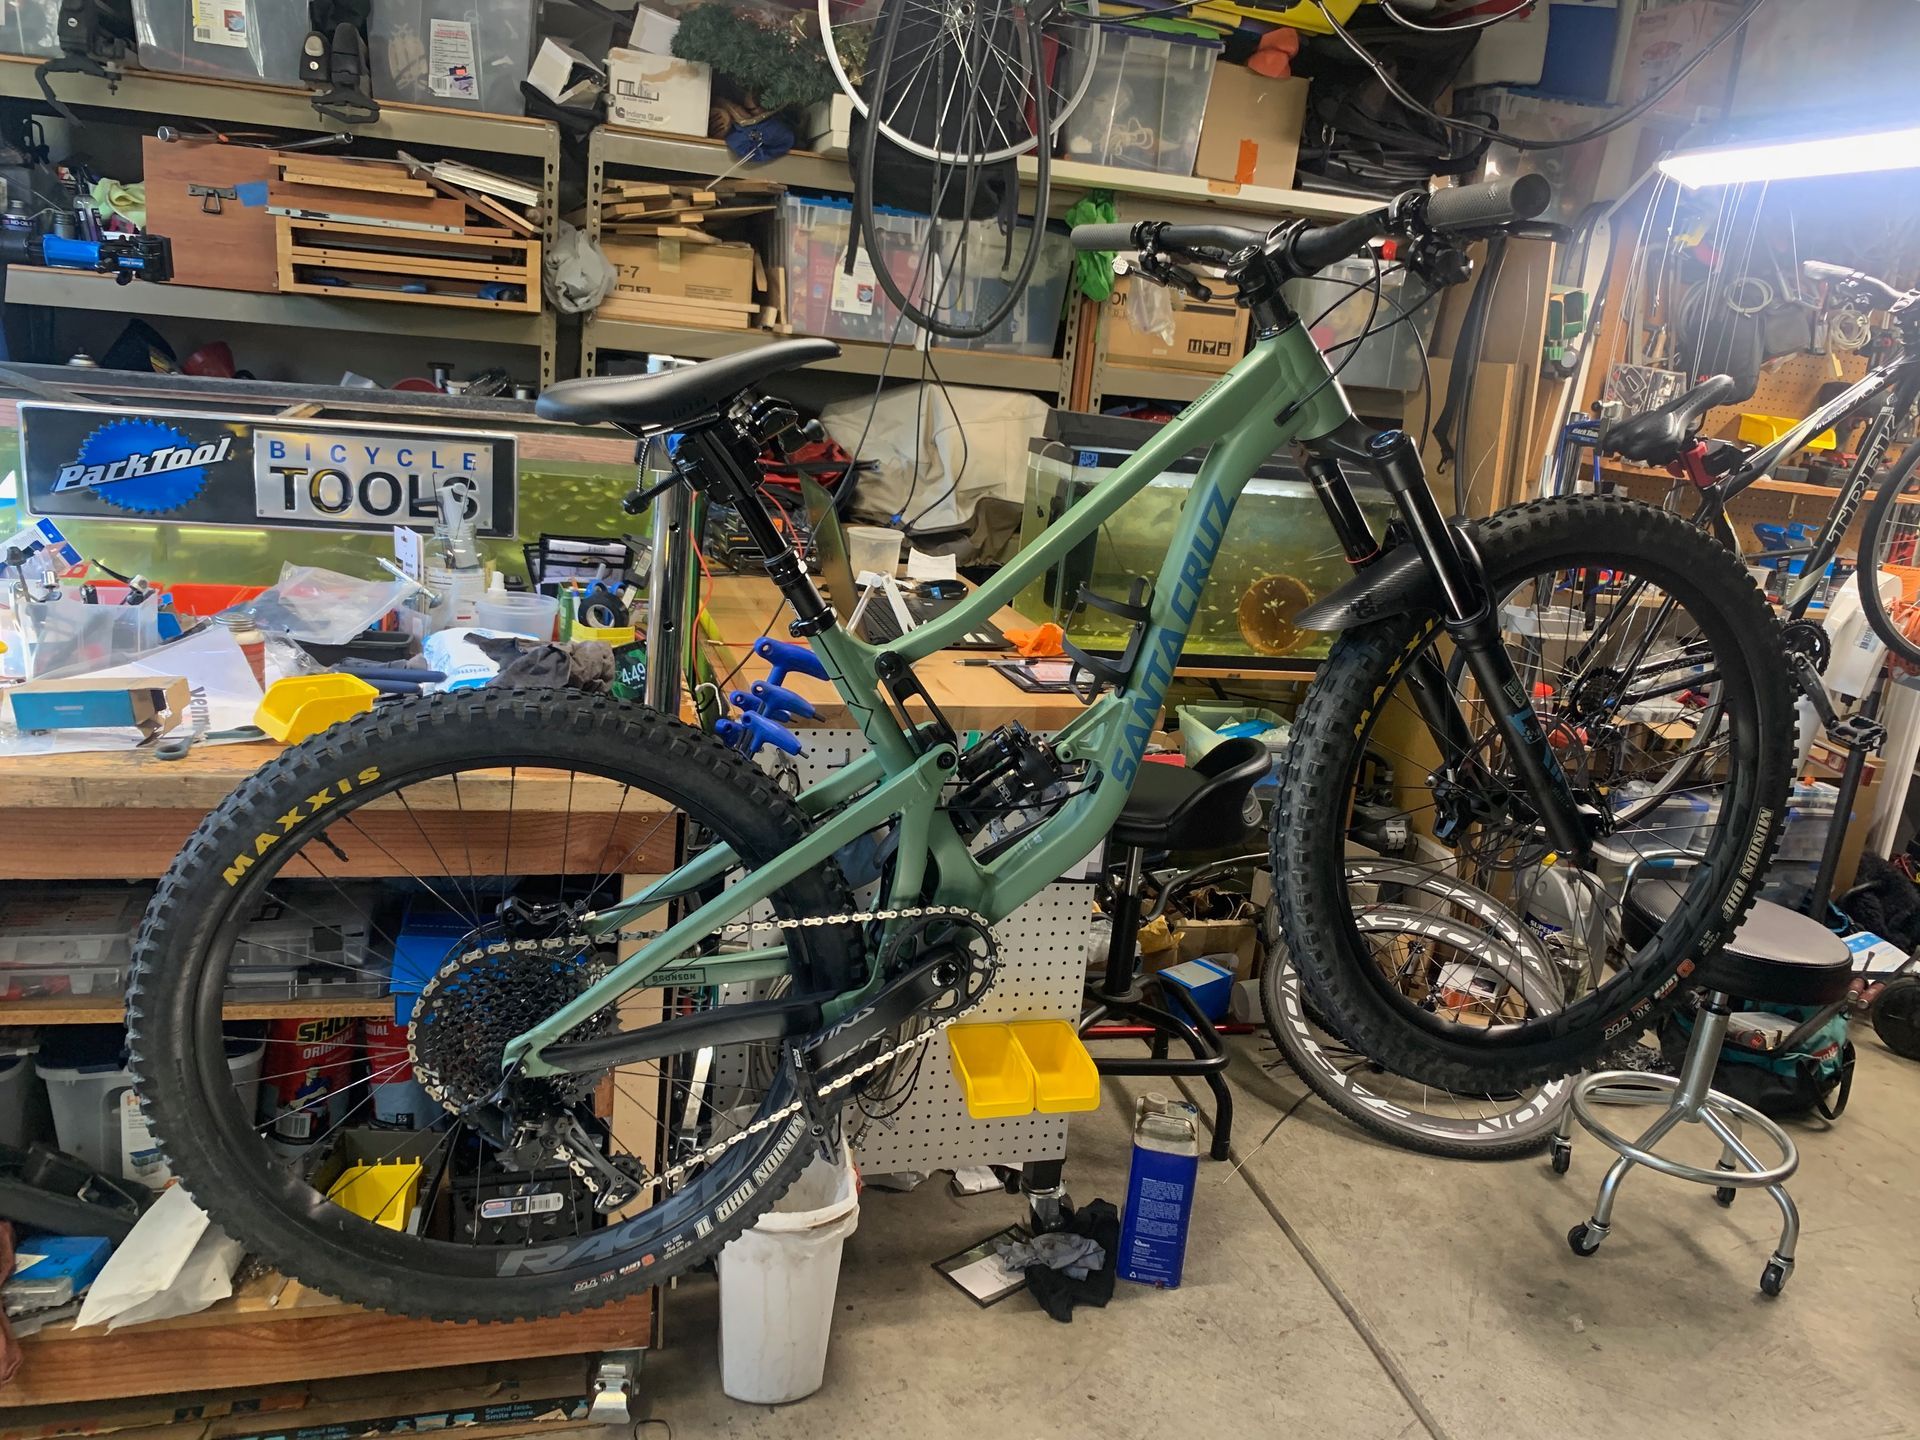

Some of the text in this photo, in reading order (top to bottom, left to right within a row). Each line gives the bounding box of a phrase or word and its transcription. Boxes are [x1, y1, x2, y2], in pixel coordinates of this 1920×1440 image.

[269, 440, 477, 471] BICYCLE
[1826, 414, 1896, 543] TREK
[269, 466, 480, 521] TOOLS
[1111, 482, 1235, 791] SANTA CRUZ
[621, 662, 646, 685] 4:49
[1354, 618, 1434, 740] MAXXI
[222, 766, 381, 887] MAXXIS
[1721, 806, 1774, 921] MINION DHF
[652, 972, 696, 982] BRONSON
[753, 1112, 807, 1186] MINION
[715, 1178, 757, 1222] DHR
[485, 1405, 510, 1416] Spend
[485, 1412, 510, 1421] Smile
